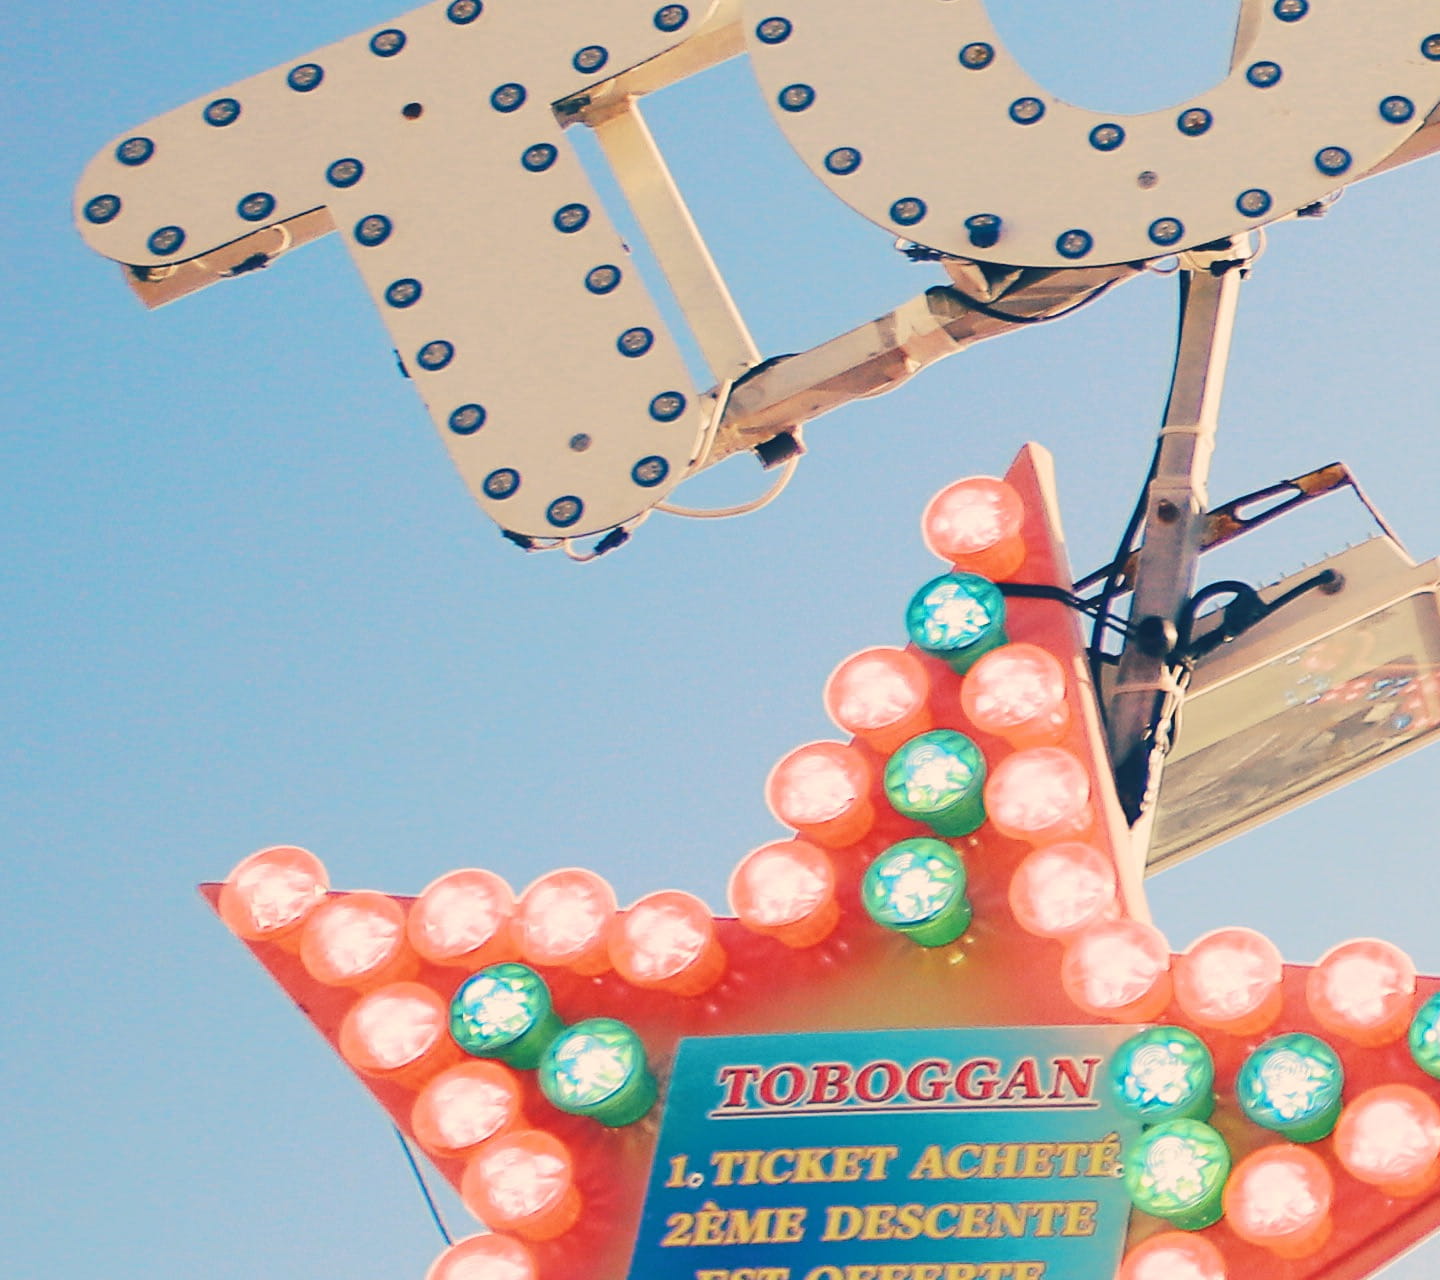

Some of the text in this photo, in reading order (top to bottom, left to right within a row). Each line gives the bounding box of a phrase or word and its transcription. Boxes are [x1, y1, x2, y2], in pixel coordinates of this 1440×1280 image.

[719, 1058, 1102, 1108] TOBOGGAN
[712, 1144, 898, 1187] TICKET
[910, 1133, 1122, 1180] ACHETÉ
[662, 1201, 1097, 1247] 2ÈME DESCENTE
